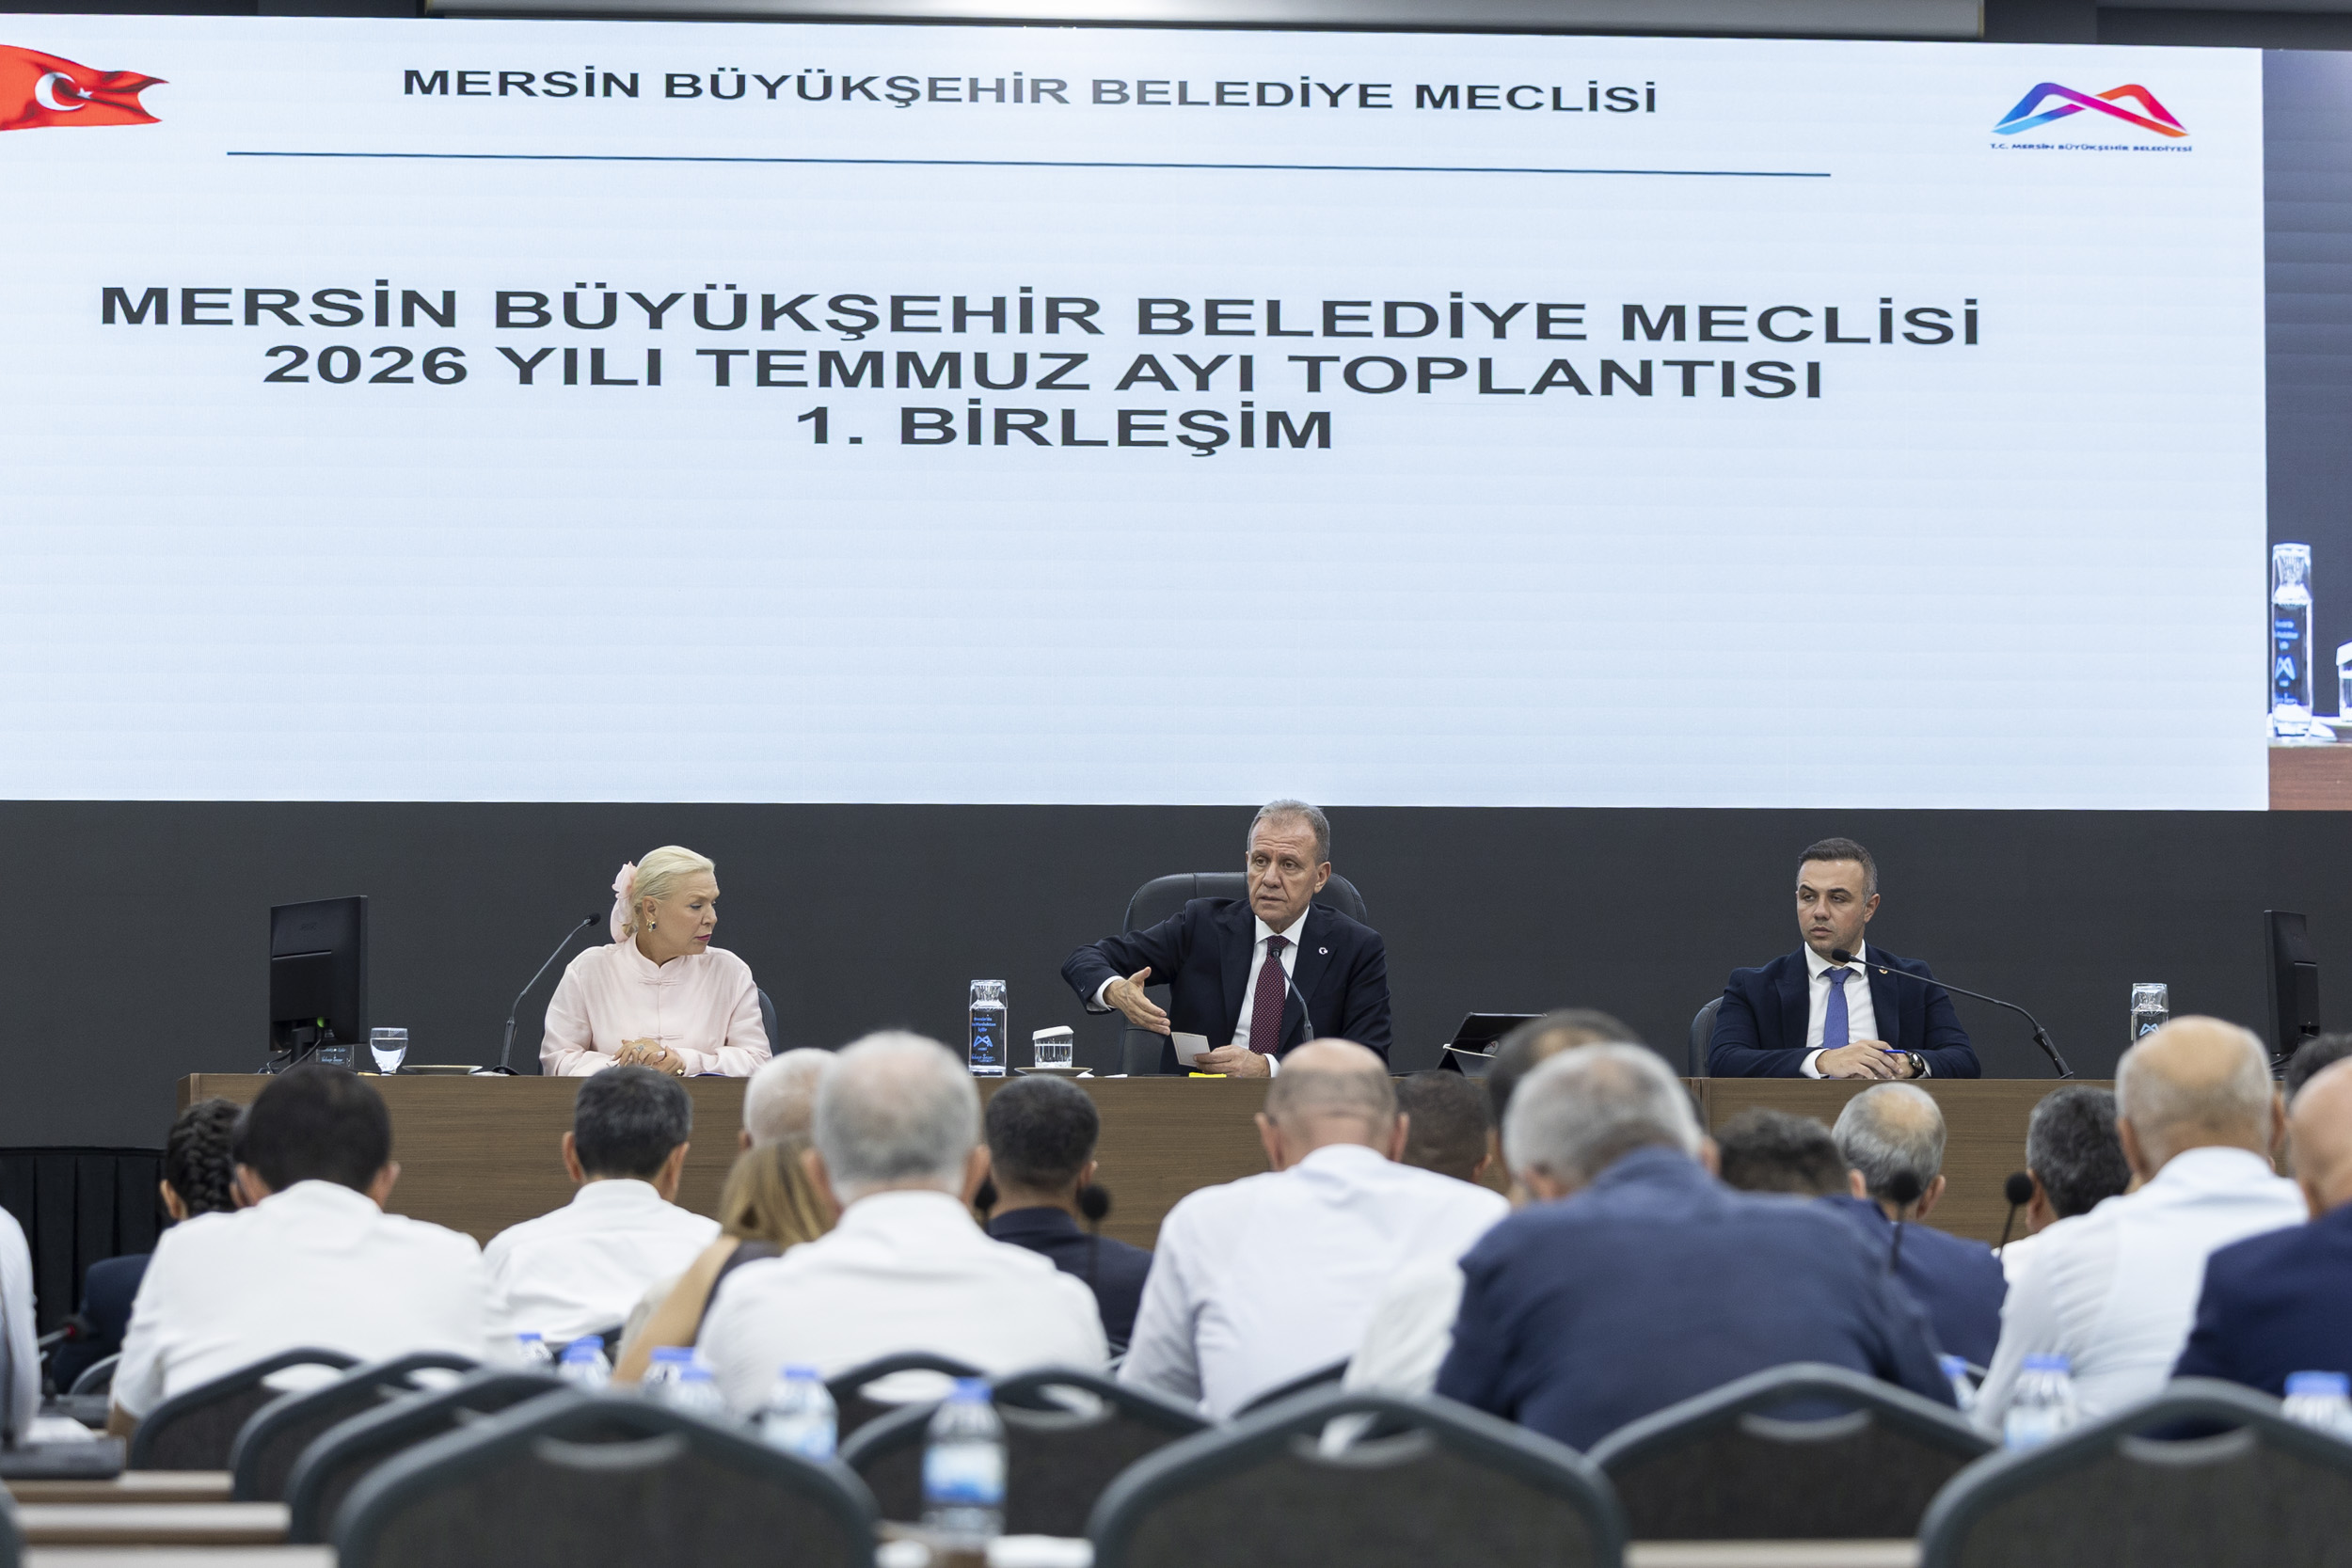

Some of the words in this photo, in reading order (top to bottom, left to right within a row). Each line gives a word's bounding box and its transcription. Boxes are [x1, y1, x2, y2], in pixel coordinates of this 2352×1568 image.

[404, 65, 640, 99] MERSİN
[664, 67, 1071, 109] BÜYÜKŞEHİR
[1091, 75, 1394, 109] BELEDİYE
[1415, 80, 1656, 113] MECLİSİ
[2058, 143, 2129, 151] BÜYÜKŞEHİR
[102, 278, 456, 328] MERSİN
[495, 281, 1105, 341] BÜYÜKŞEHİR
[1137, 291, 1588, 341] BELEDİYE
[1622, 296, 1979, 346] MECLİSİ
[262, 344, 469, 386] 2026
[495, 346, 661, 387] YILI
[695, 348, 1090, 391] TEMMUZ
[1113, 353, 1254, 393] AYI
[1287, 355, 1820, 399] TOPLANTISI
[797, 406, 863, 445] 1.
[900, 397, 1332, 458] BİRLEŞİM
